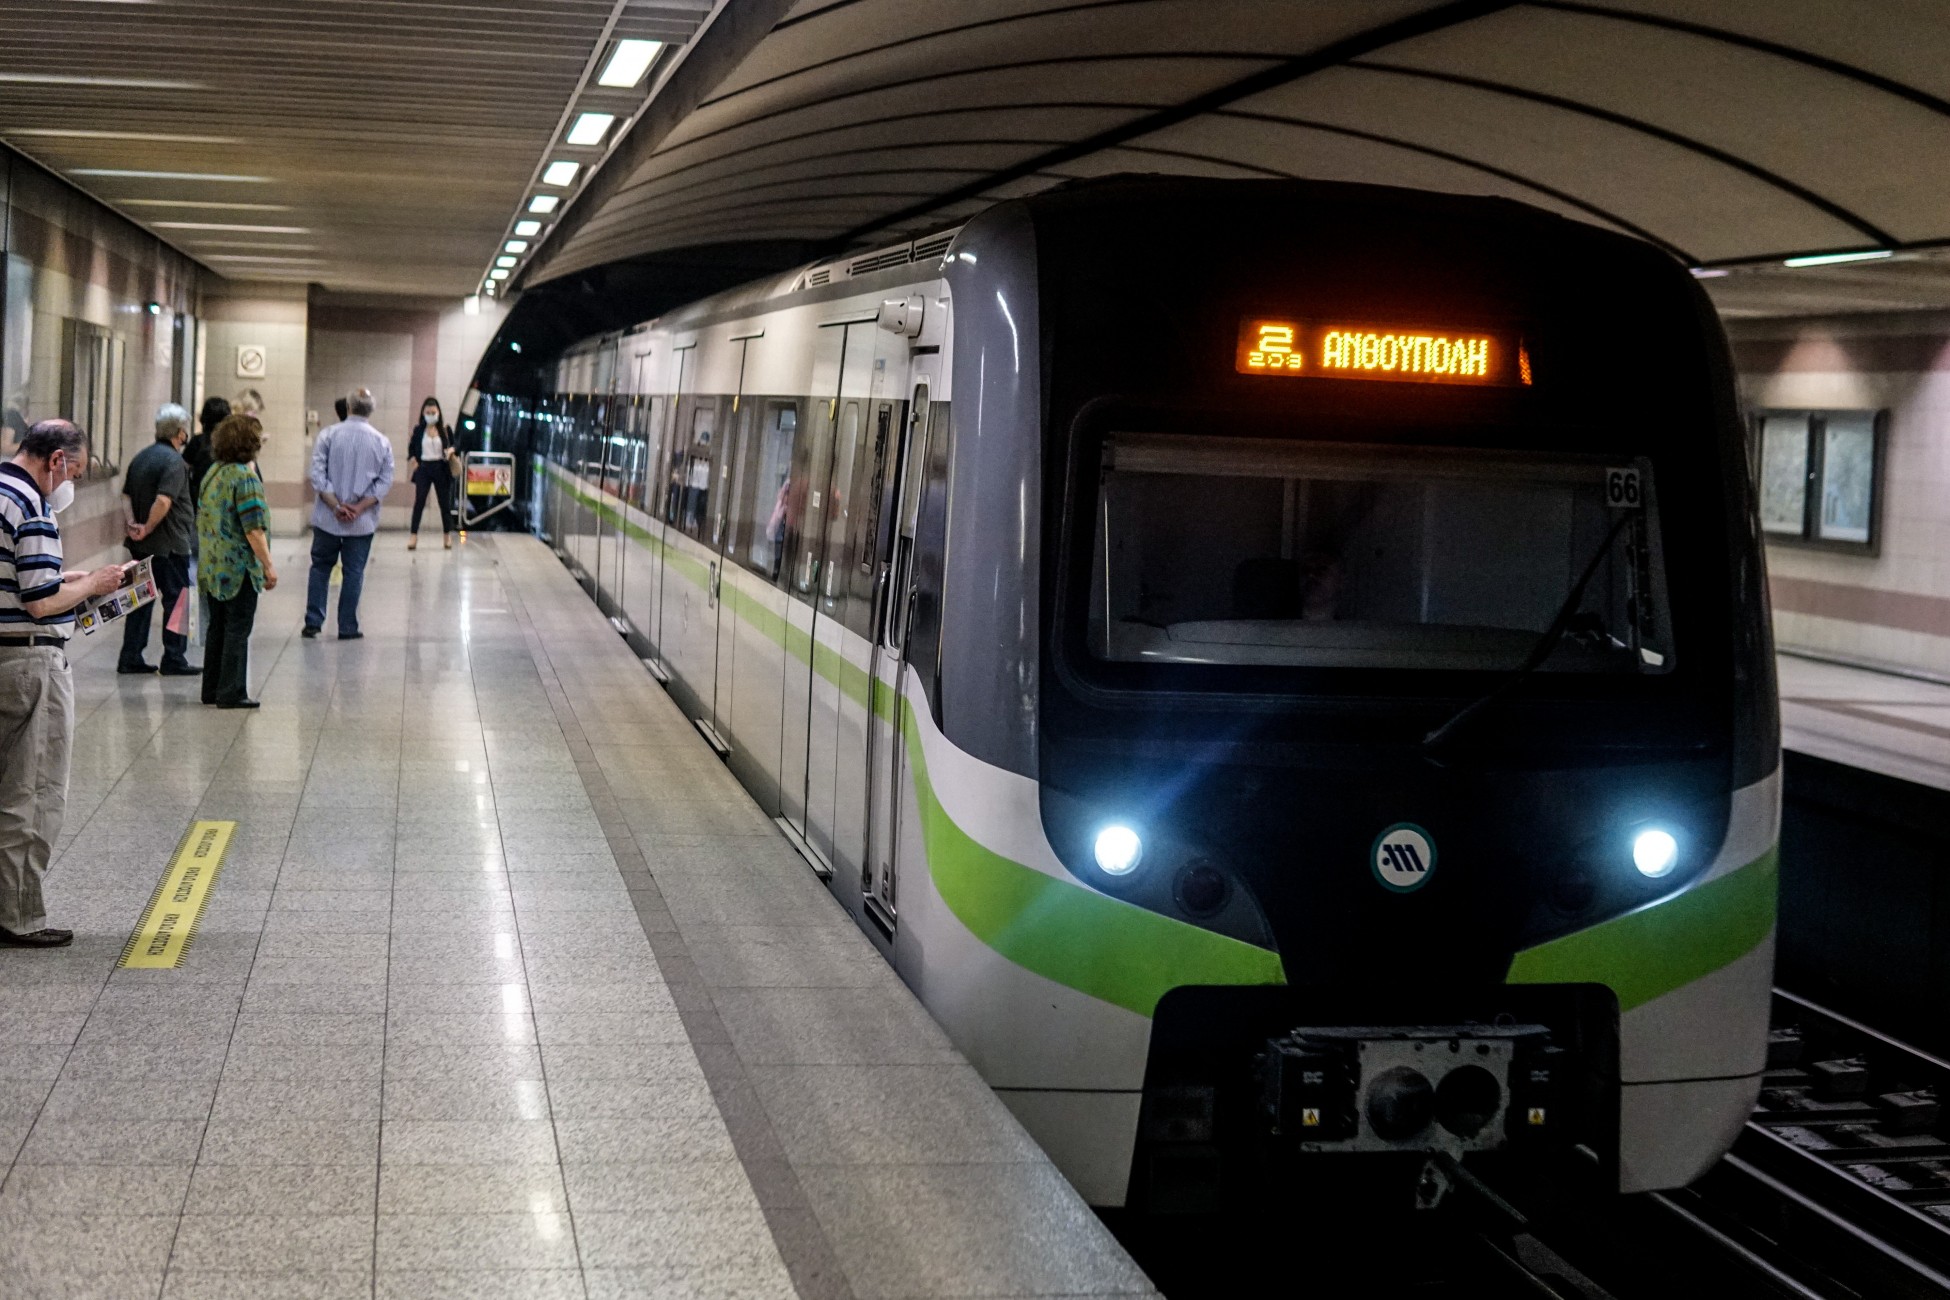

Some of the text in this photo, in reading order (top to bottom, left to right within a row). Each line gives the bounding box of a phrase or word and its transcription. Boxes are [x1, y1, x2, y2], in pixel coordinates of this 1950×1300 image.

[1259, 326, 1293, 353] 2
[1323, 332, 1488, 376] ΑΝΘΟΥΠΟΛΗ
[1610, 472, 1638, 503] 66
